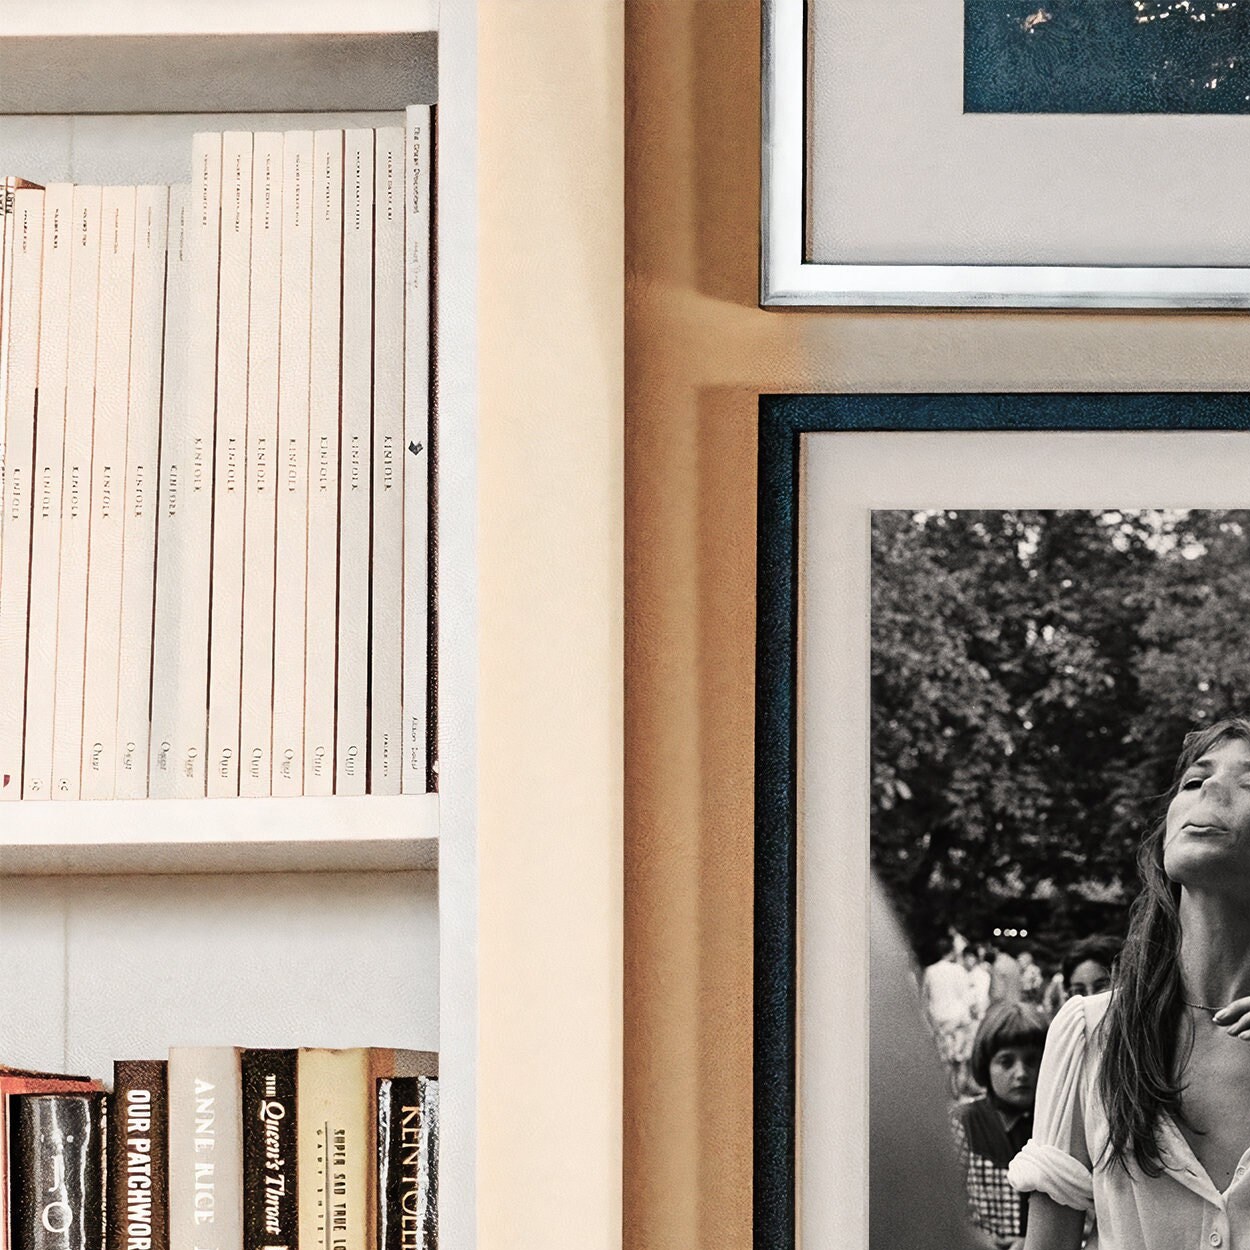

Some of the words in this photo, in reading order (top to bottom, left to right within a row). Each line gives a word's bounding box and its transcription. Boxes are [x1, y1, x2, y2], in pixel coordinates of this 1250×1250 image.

[127, 1089, 152, 1132] OUR
[194, 1077, 217, 1153] ANNE
[259, 1100, 286, 1171] Queen's
[194, 1162, 216, 1225] RICE
[265, 1173, 286, 1236] Throat
[333, 1173, 346, 1195] SAD
[333, 1202, 346, 1231] TRUE
